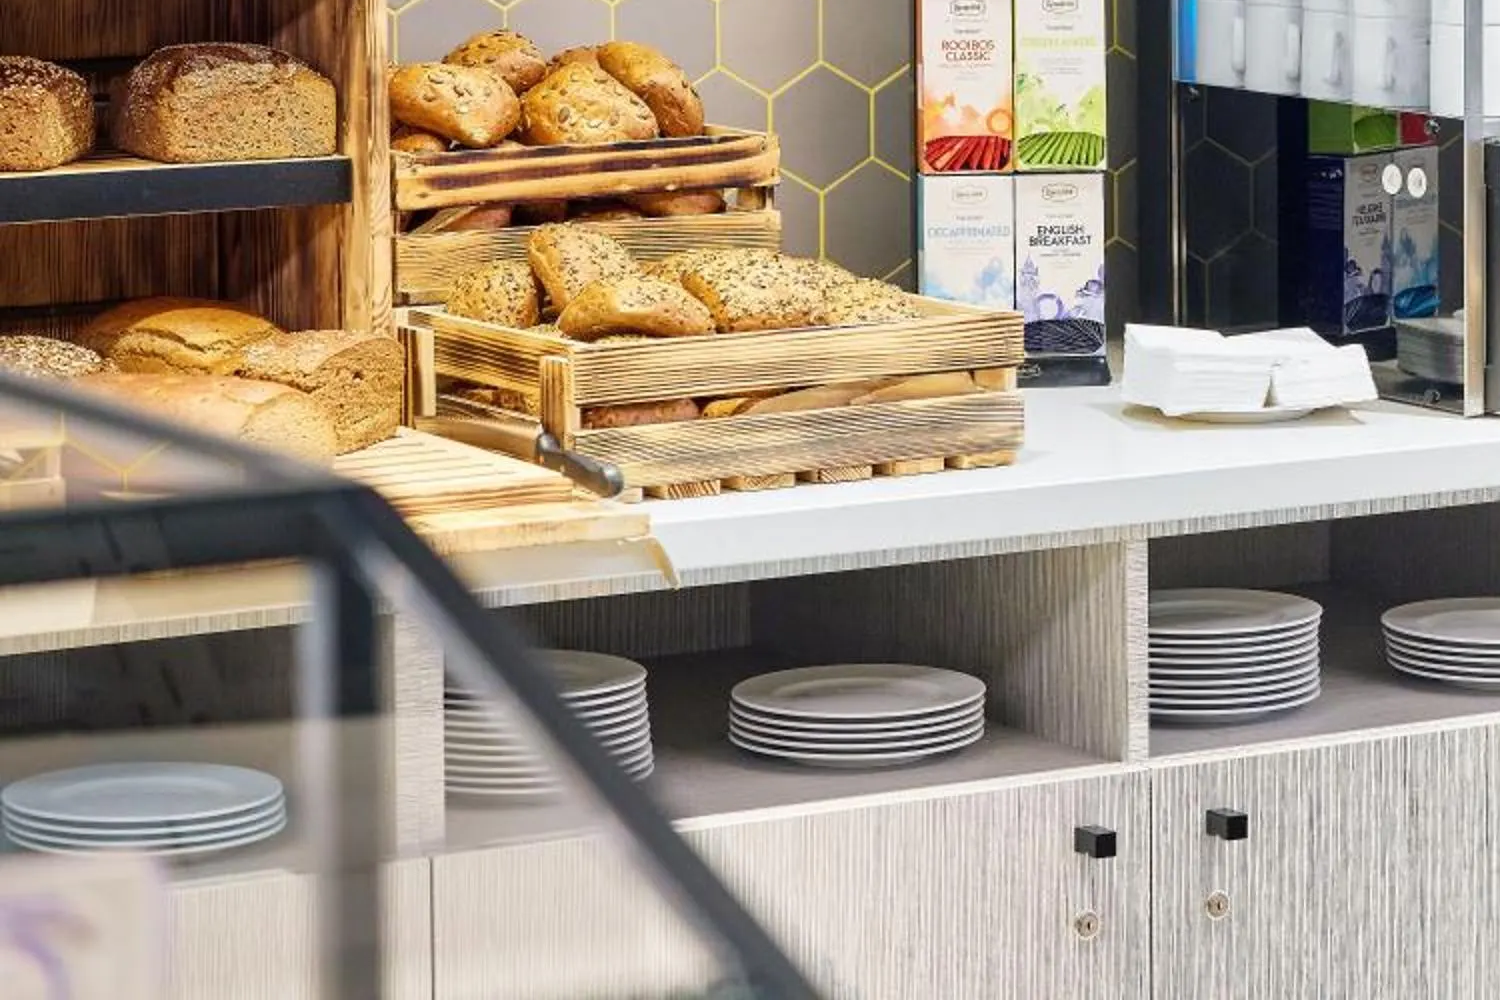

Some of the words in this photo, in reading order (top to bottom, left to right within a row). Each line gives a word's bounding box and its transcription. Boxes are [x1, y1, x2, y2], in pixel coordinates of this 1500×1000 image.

[941, 39, 996, 51] ROOIBOS
[945, 51, 991, 62] CLASSIC
[1036, 225, 1085, 236] ENGLISH
[1028, 235, 1092, 247] BREAKFAST
